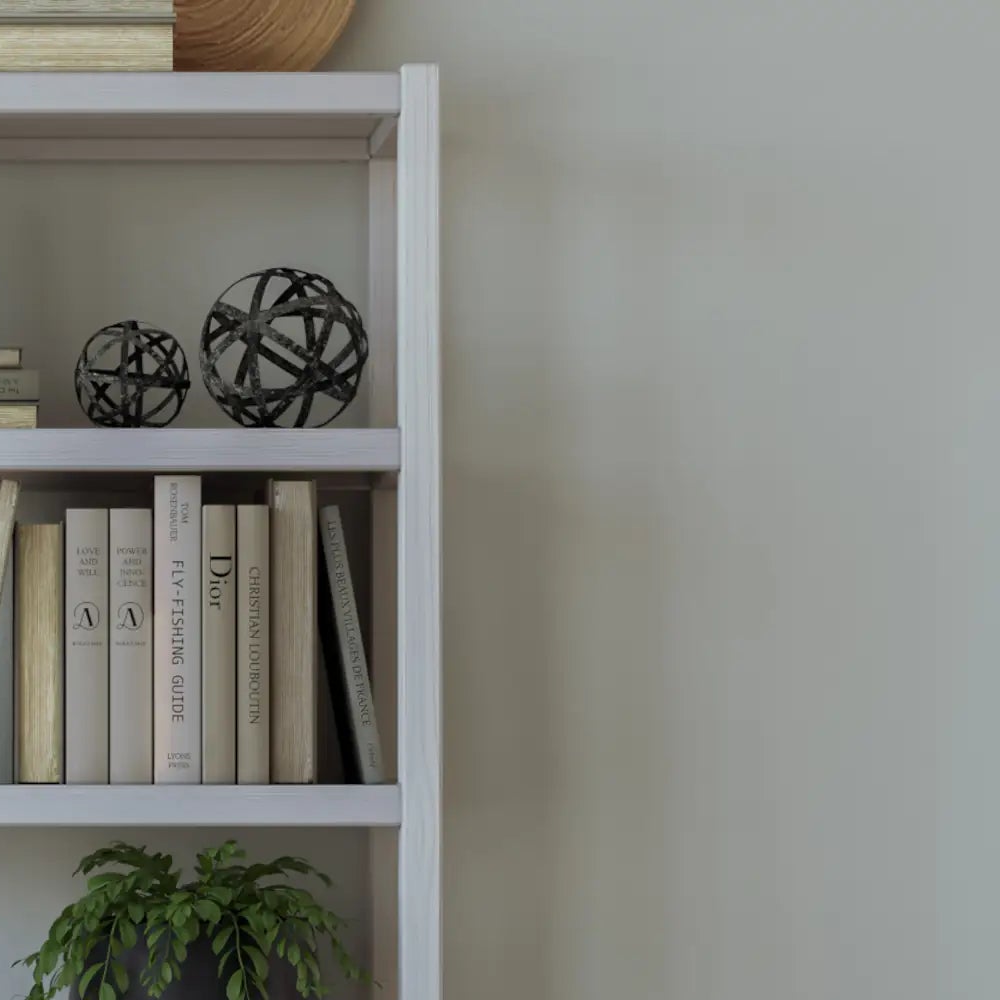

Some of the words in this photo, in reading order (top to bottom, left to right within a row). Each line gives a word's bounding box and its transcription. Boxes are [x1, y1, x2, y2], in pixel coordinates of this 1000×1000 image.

[180, 502, 190, 524] TOM
[327, 521, 338, 540] LES
[76, 546, 101, 555] LOVE
[79, 558, 98, 566] AND
[116, 546, 148, 555] POWER
[122, 558, 142, 566] AND
[207, 552, 233, 611] Dior
[335, 571, 351, 608] BEAUX
[171, 560, 185, 665] FLY-FISHING
[248, 566, 261, 638] CHRISTIAN
[344, 609, 361, 665] VILLAGES
[248, 643, 261, 724] LOUBOUTIN
[352, 665, 363, 680] DE
[171, 675, 185, 723] GUIDE
[355, 682, 372, 727] FRANCE
